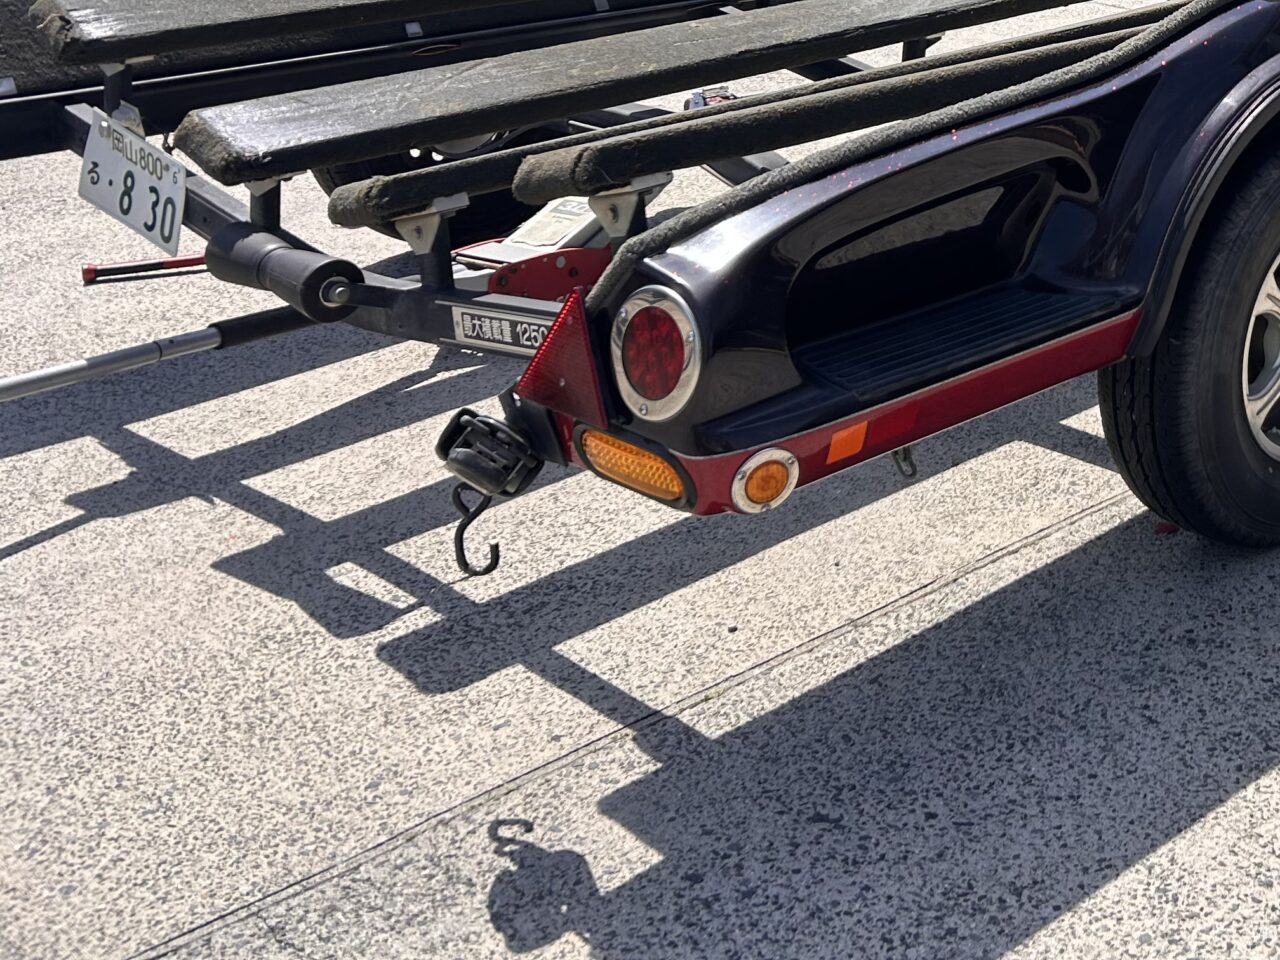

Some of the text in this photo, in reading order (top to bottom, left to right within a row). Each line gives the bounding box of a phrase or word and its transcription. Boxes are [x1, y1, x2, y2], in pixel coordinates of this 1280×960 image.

[463, 314, 513, 343] 最大積載量
